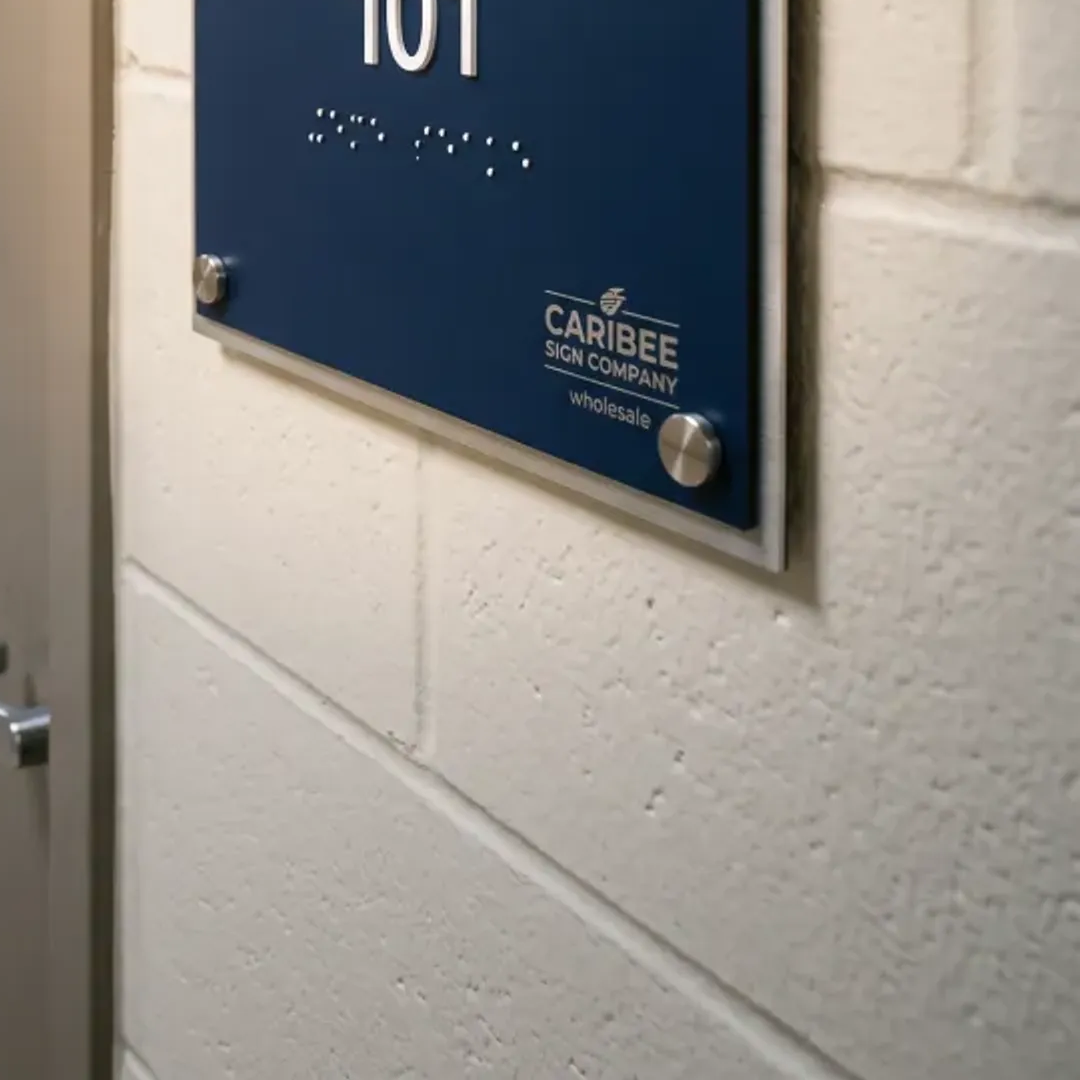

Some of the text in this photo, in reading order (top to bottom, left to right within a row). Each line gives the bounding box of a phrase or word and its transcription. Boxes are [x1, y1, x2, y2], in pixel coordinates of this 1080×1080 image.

[544, 304, 679, 370] CARIBEE
[544, 340, 679, 395] SIGN COMPANY
[569, 389, 652, 430] wholesale
